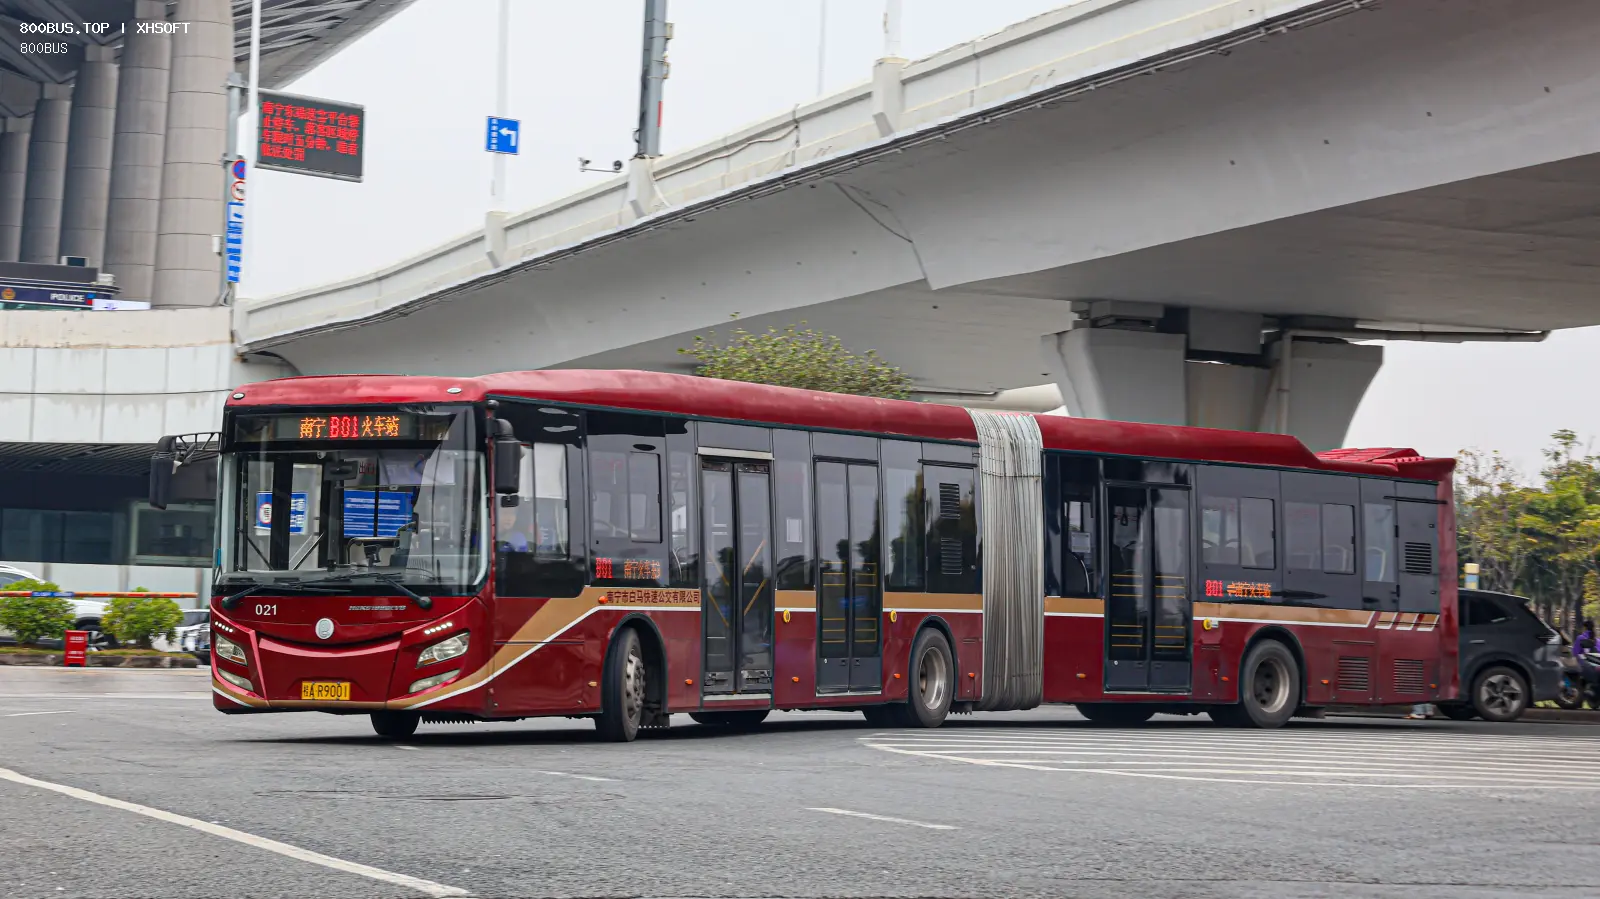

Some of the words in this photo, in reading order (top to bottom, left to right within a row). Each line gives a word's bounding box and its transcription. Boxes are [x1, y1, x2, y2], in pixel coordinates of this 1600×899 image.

[50, 293, 84, 303] POLICE
[299, 417, 326, 439] 南宁
[329, 415, 359, 439] B01
[361, 415, 400, 437] 火车站
[255, 604, 277, 616] 021
